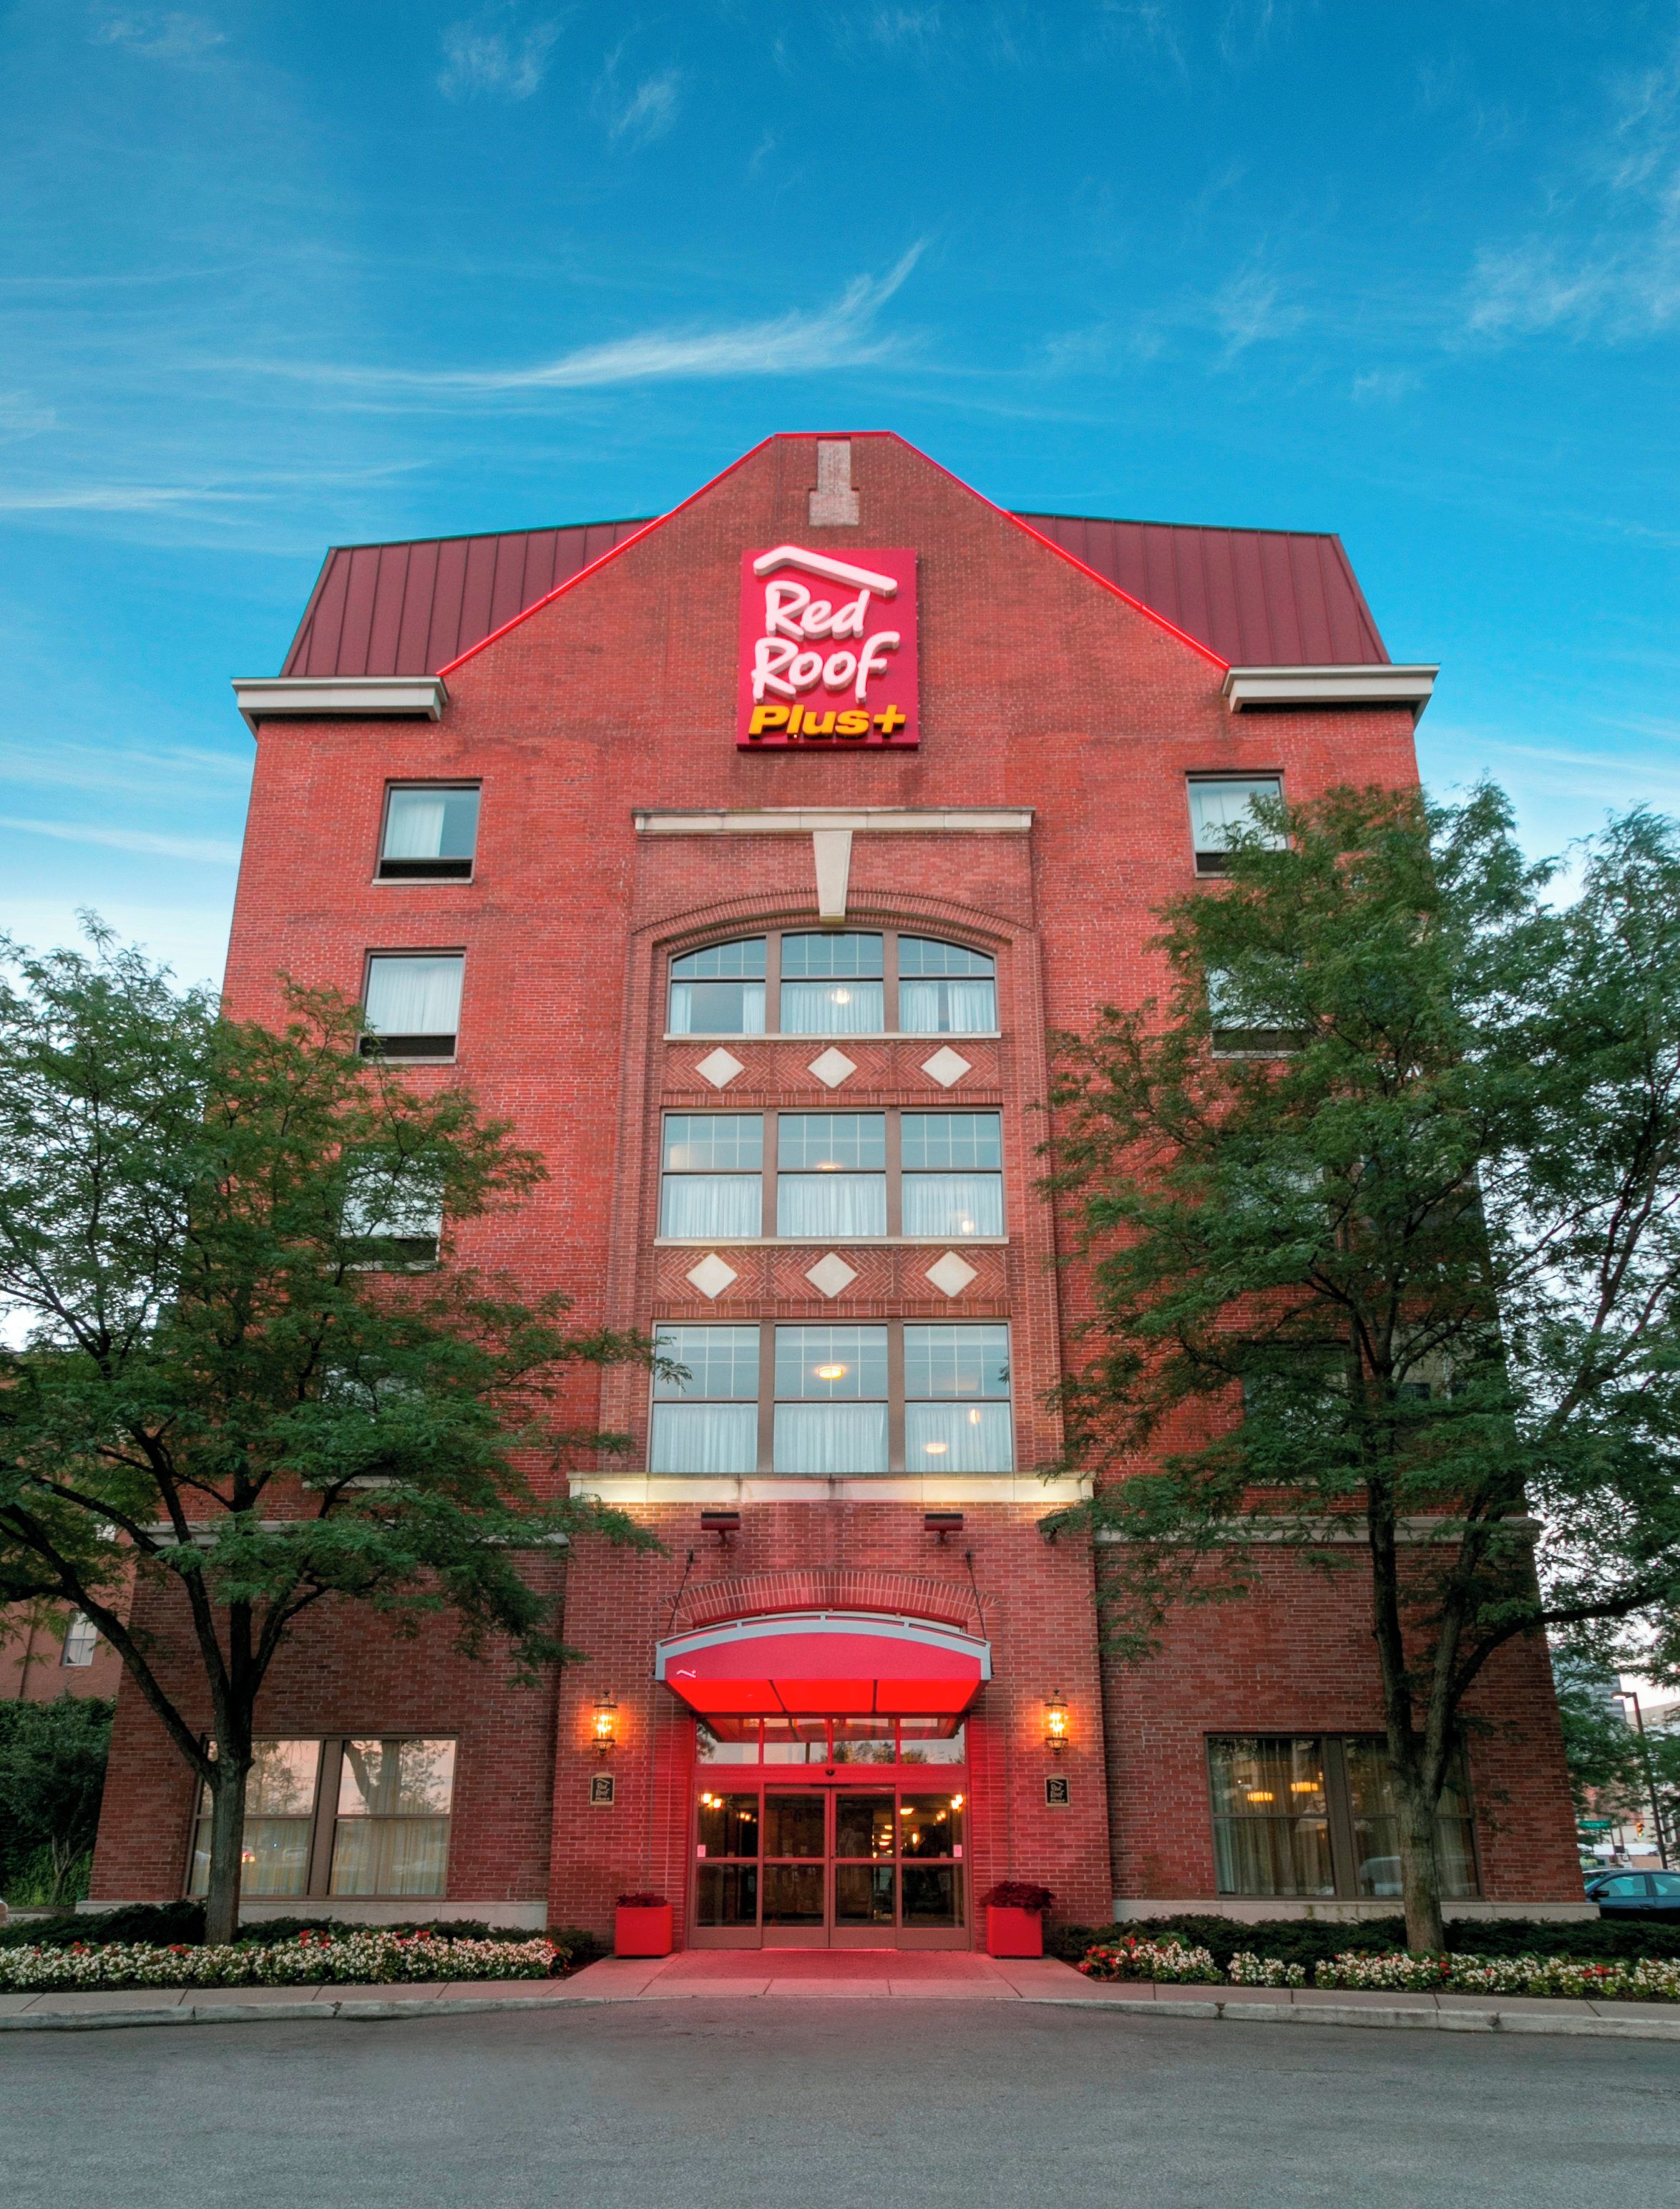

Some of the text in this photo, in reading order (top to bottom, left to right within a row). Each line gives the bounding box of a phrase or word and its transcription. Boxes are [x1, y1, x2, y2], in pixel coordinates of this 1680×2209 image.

[765, 580, 871, 642] Red
[751, 631, 901, 704] Roof
[748, 704, 907, 740] Plus+
